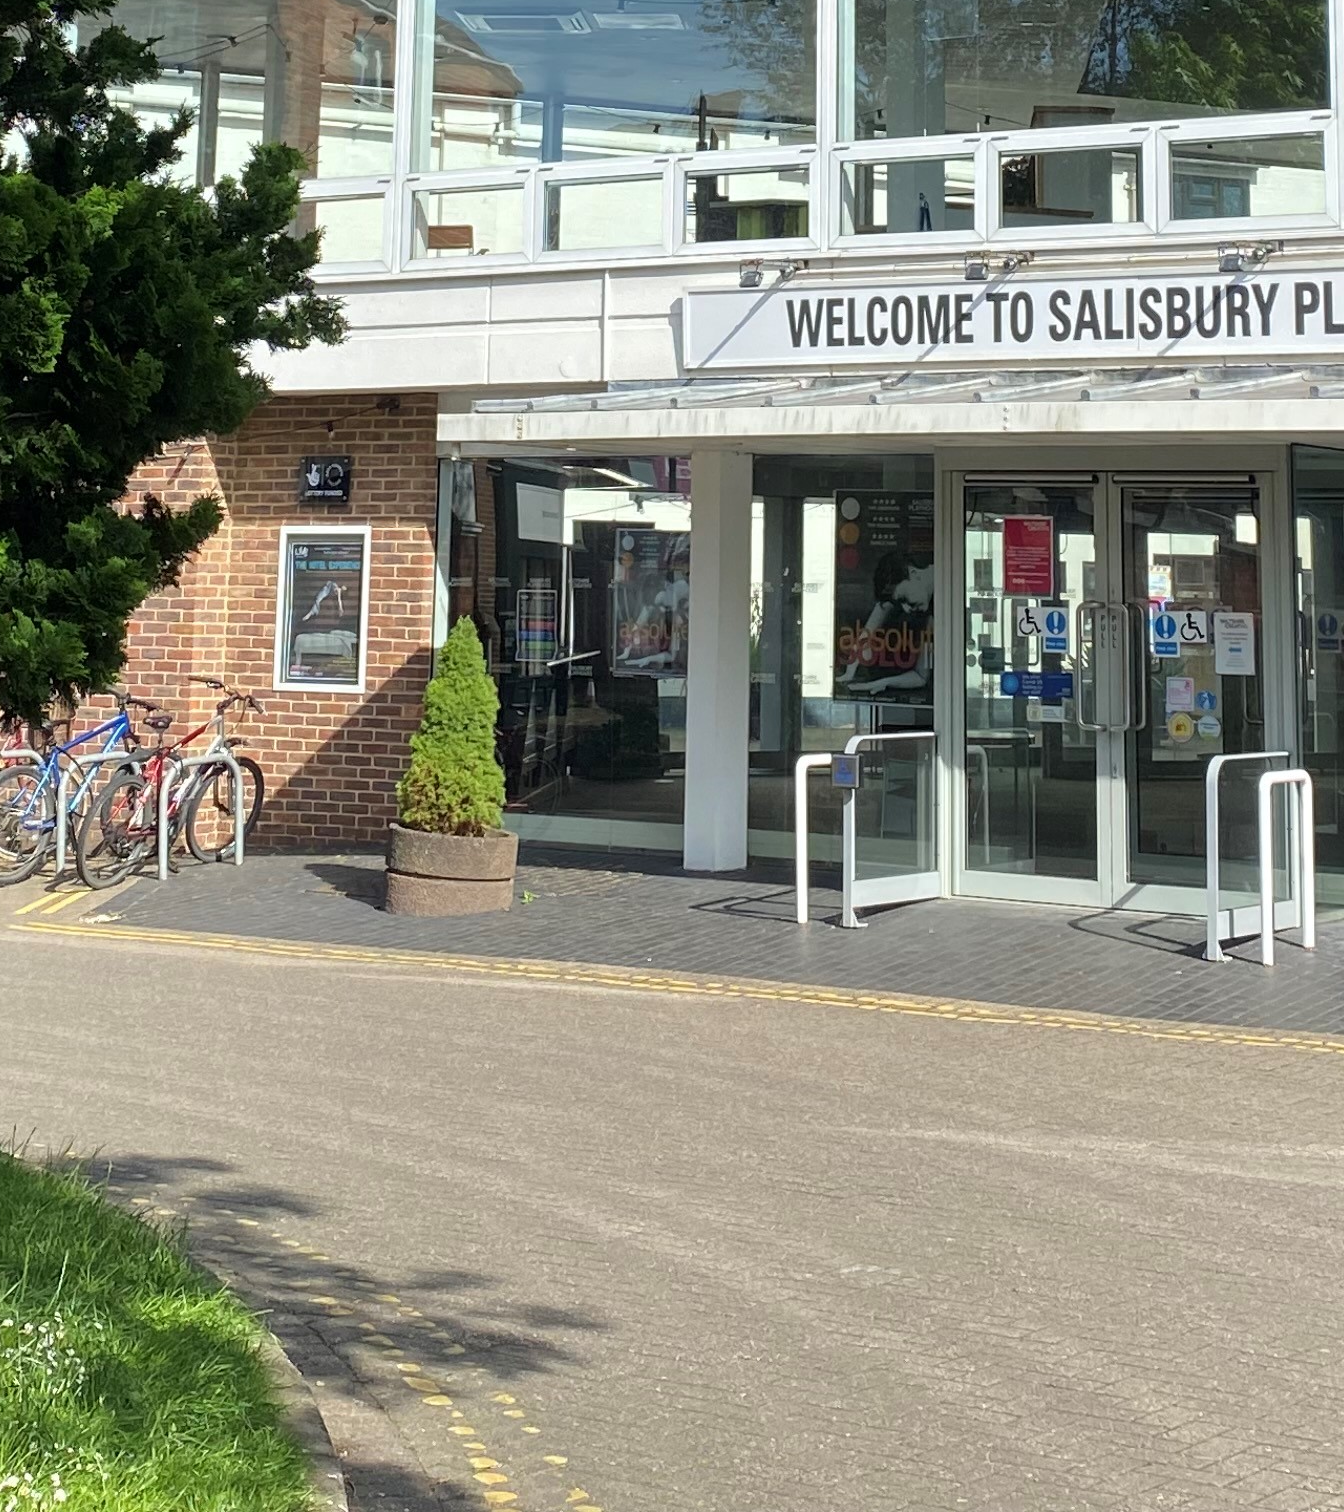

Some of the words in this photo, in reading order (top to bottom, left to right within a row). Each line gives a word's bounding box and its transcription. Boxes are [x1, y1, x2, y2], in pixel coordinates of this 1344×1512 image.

[786, 293, 975, 349] WELCOME
[985, 291, 1034, 344] TO
[1049, 283, 1277, 343] SALISBURY
[839, 619, 933, 654] absolut
